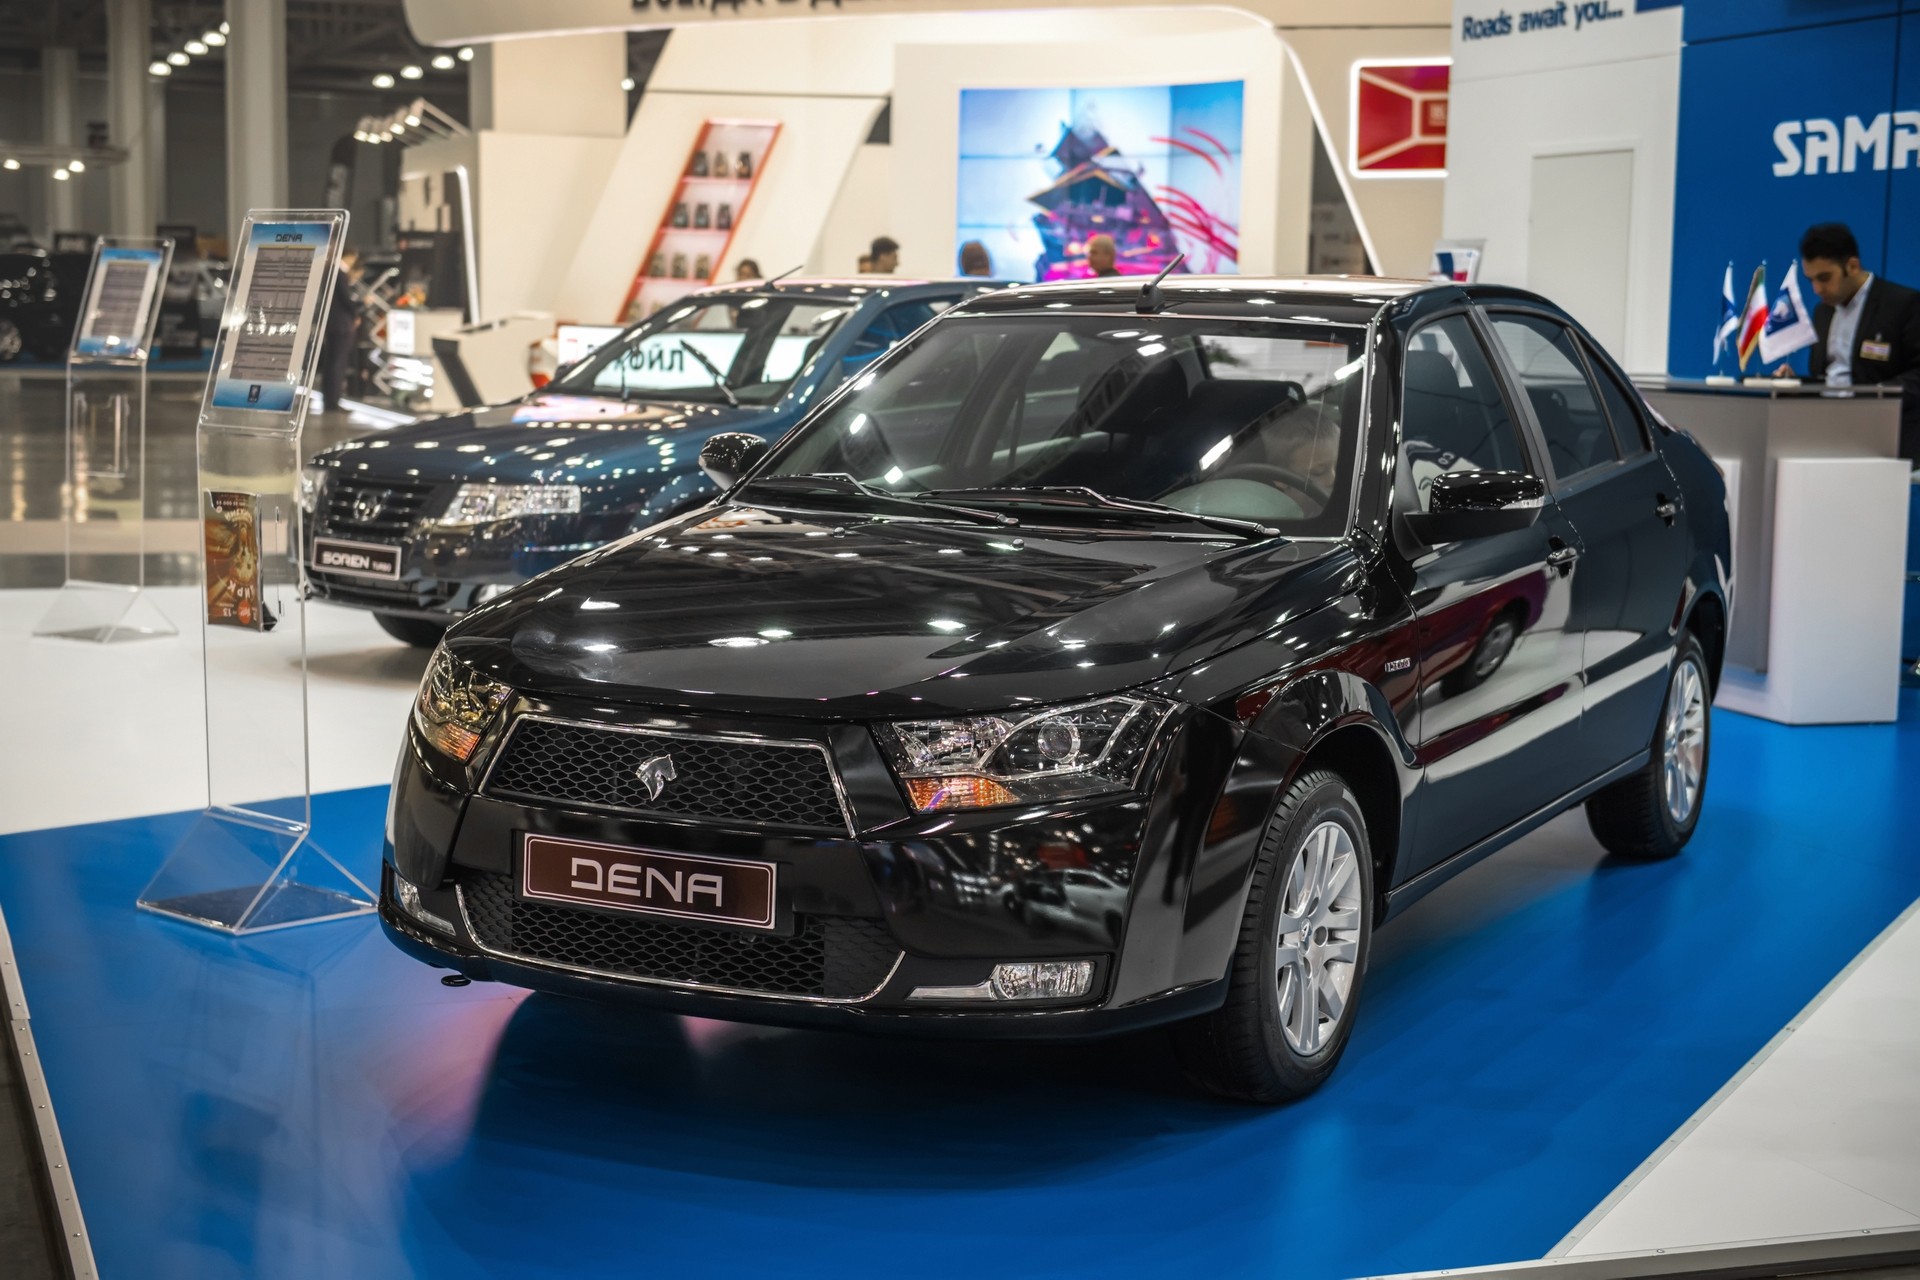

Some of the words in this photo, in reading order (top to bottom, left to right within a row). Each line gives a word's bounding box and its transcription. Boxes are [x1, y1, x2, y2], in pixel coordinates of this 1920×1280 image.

[1462, 10, 1512, 41] Roads
[1519, 0, 1567, 32] await
[275, 233, 303, 242] DENA
[322, 551, 370, 569] SOREN
[571, 857, 723, 907] DENA
